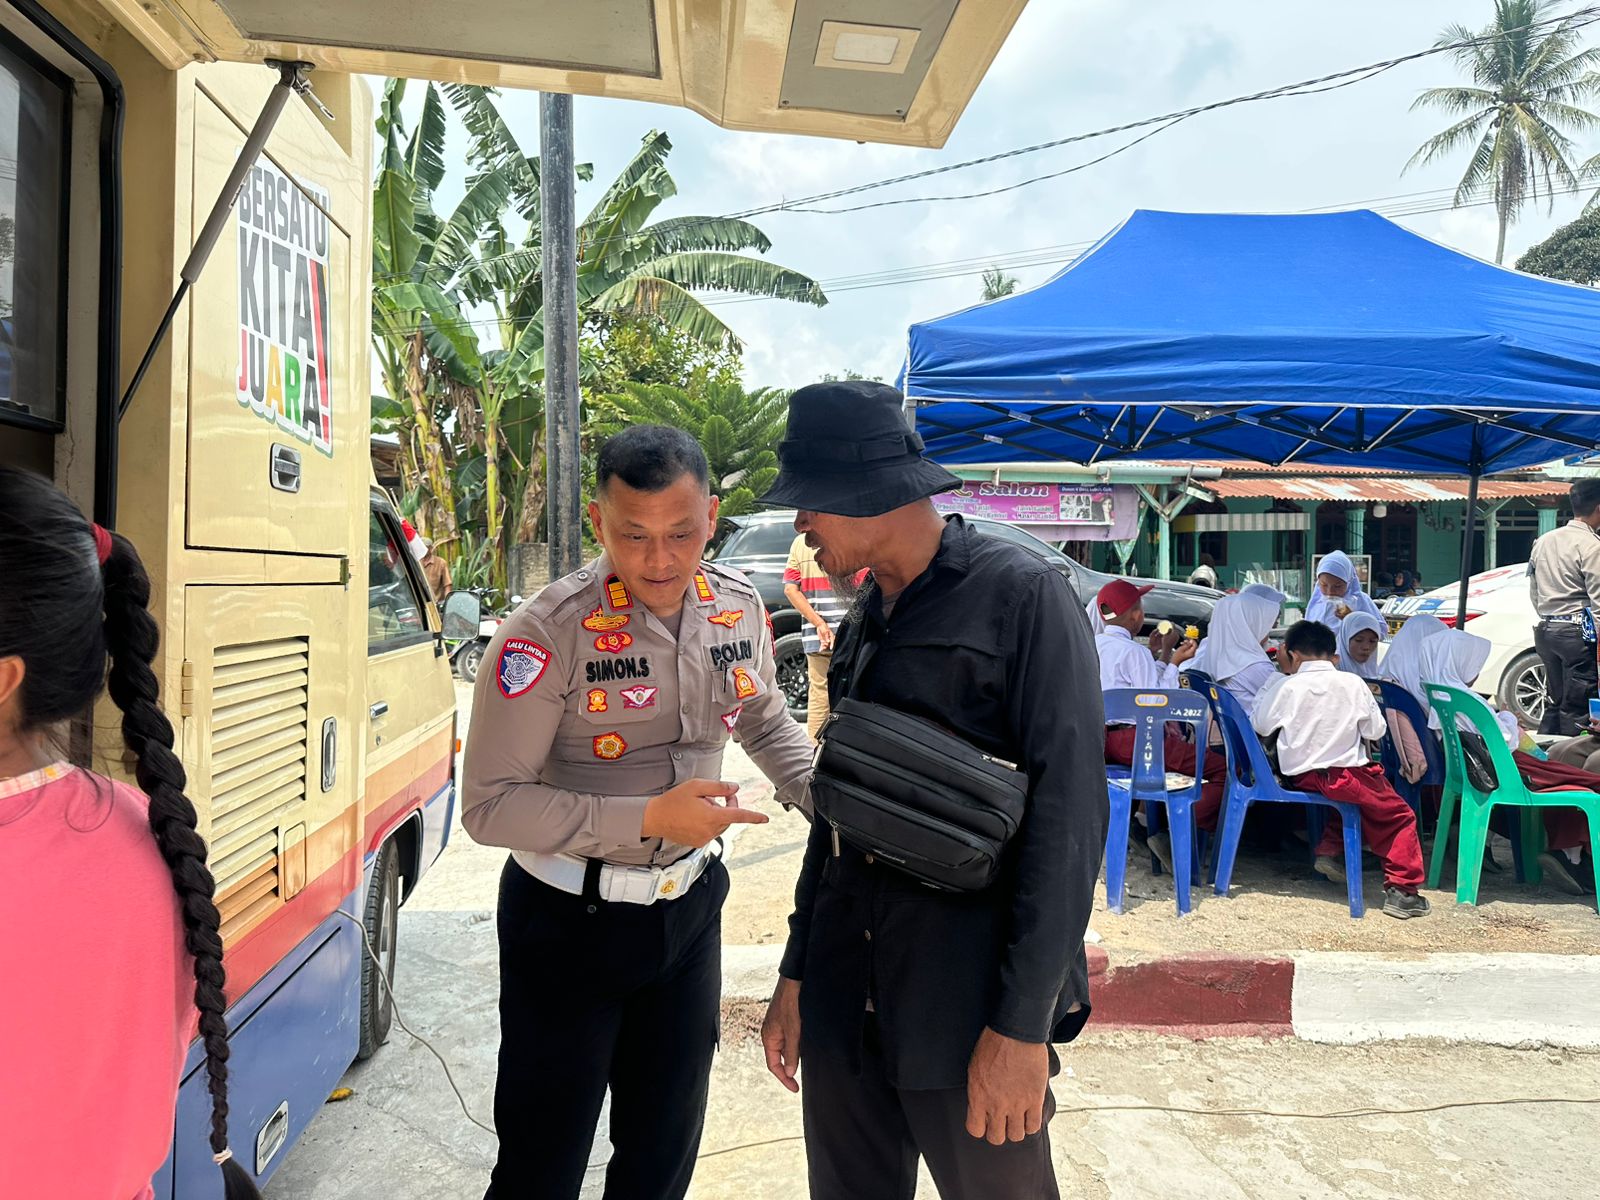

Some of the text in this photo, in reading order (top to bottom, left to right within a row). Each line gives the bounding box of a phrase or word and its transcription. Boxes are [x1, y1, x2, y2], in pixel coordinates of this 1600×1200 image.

[239, 165, 327, 258] BERSATU
[239, 225, 316, 362] KITA
[979, 481, 1049, 498] Salon
[507, 641, 547, 660] LALU LINTAS
[710, 640, 752, 667] POLRI
[585, 657, 650, 683] SIMON.S
